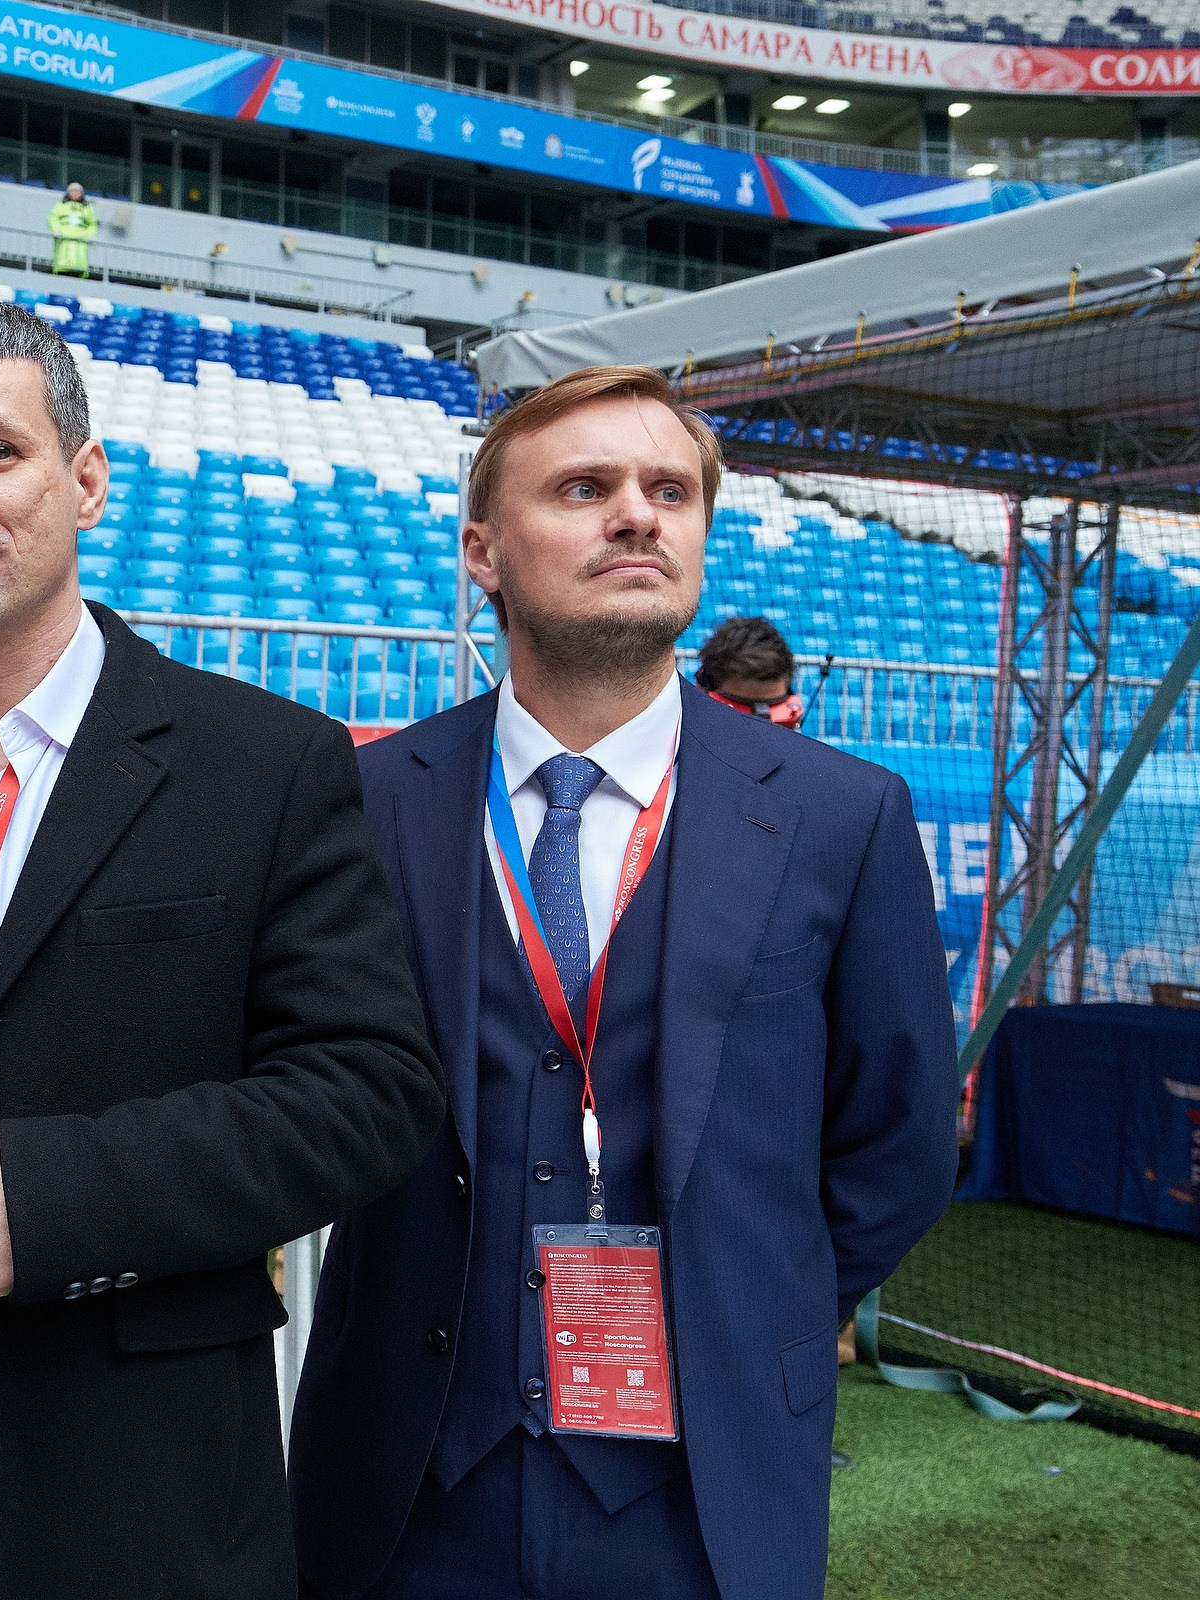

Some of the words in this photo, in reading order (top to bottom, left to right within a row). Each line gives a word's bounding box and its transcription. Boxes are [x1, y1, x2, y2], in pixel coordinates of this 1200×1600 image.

[14, 46, 115, 85] FORUM
[678, 16, 813, 65] САМАРА
[827, 40, 933, 77] АРЕНА
[617, 826, 648, 908] ROSCONGRESS
